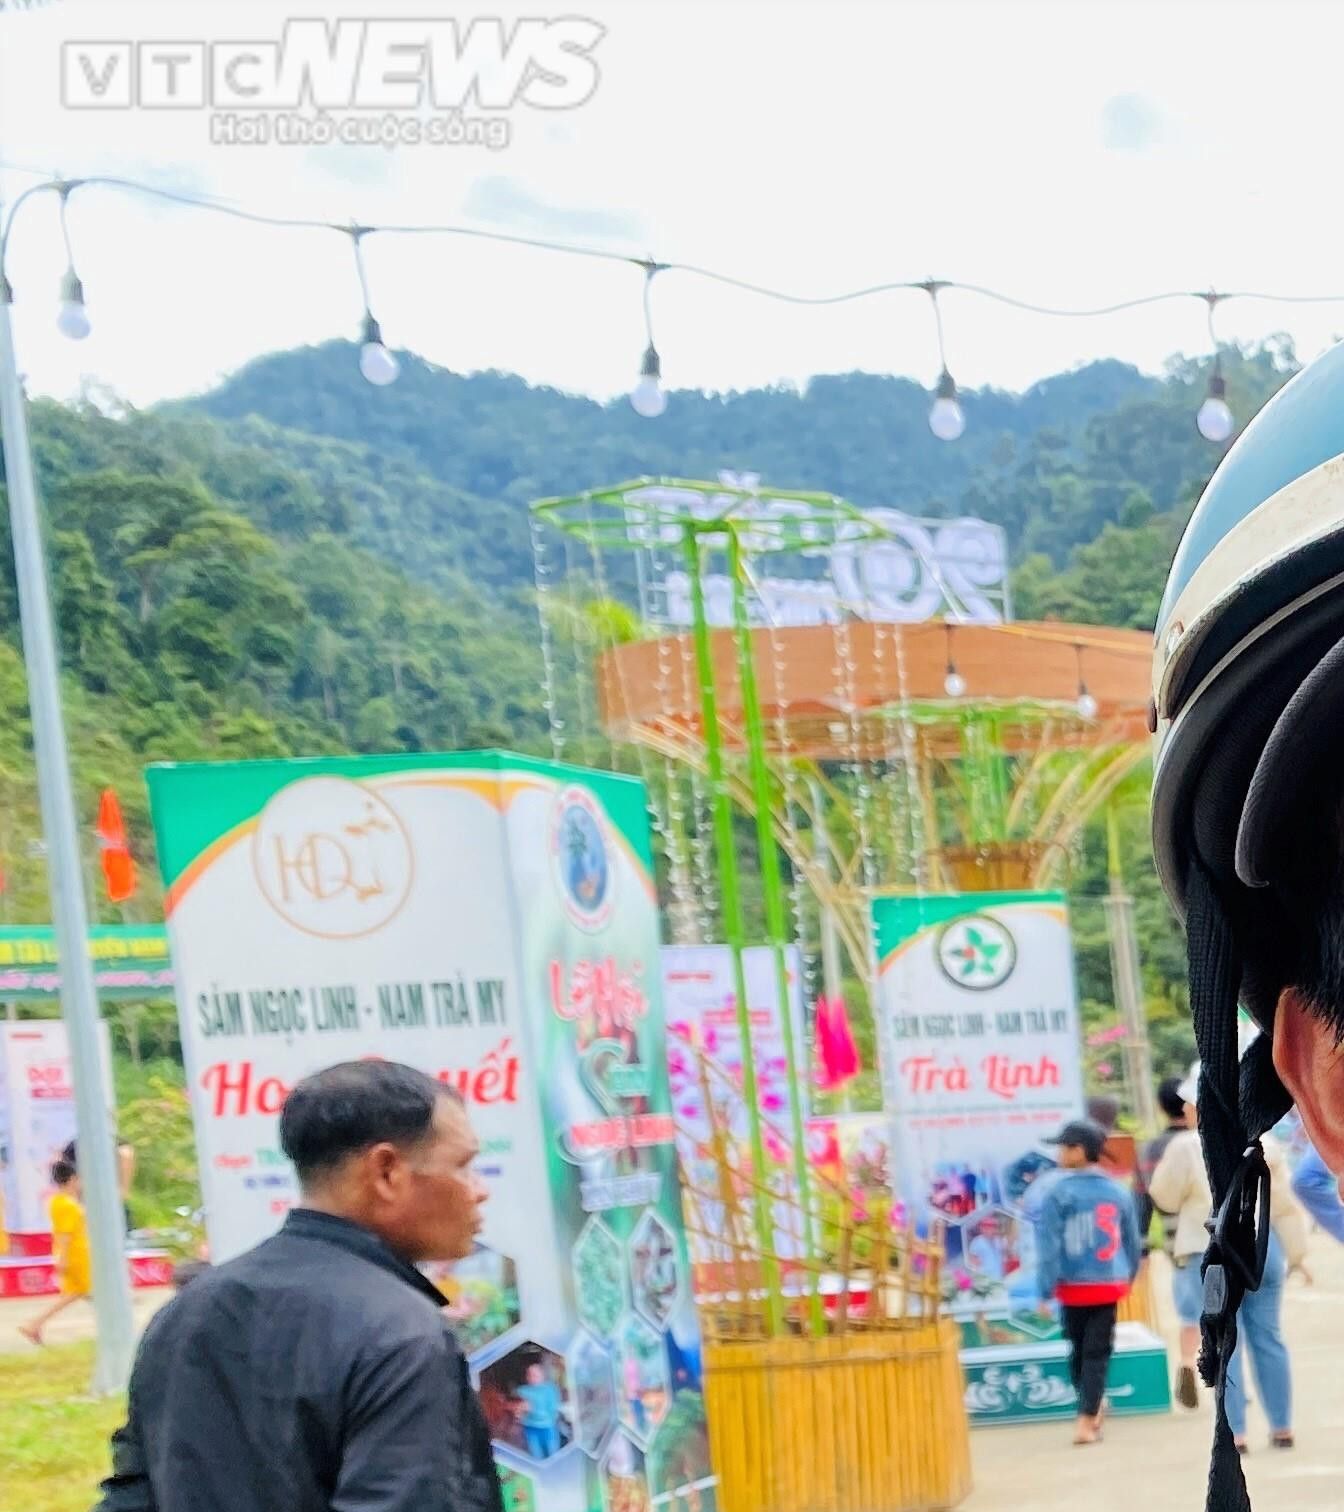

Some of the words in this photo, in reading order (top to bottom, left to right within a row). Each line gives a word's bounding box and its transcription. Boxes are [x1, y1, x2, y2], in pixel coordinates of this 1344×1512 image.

[252, 988, 306, 1047] NGỌC
[312, 985, 359, 1031] LINH
[378, 983, 426, 1029] NAM
[430, 972, 472, 1028] TRÀ
[475, 979, 508, 1026] MY
[980, 1054, 1061, 1099] Linh
